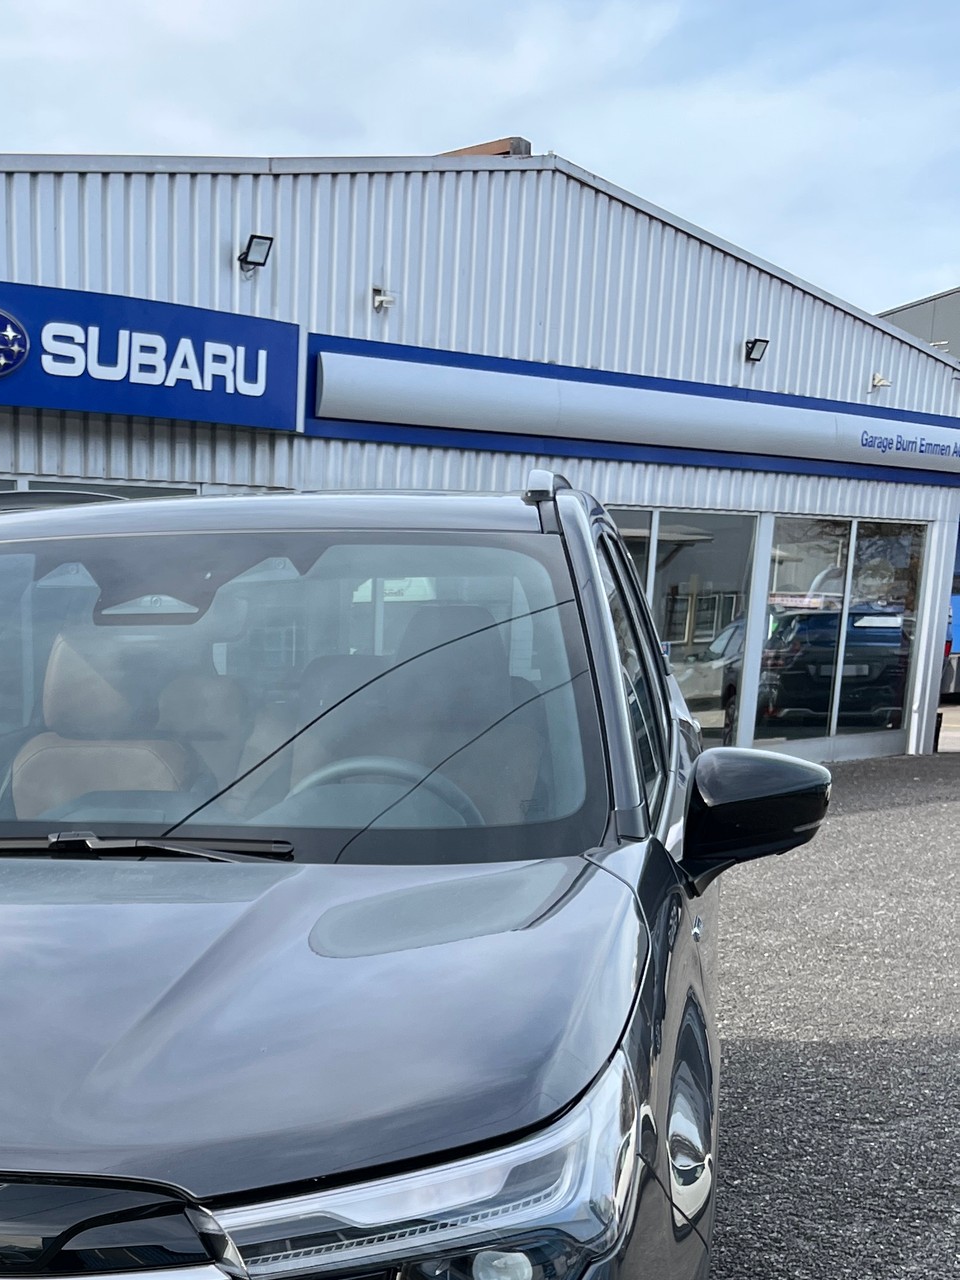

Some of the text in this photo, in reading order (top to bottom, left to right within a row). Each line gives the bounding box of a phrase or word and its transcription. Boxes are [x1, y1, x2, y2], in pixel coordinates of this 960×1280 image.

[40, 321, 267, 398] SUBARU
[861, 430, 893, 453] Garage
[895, 434, 917, 452] Burri
[919, 437, 951, 456] Emmen
